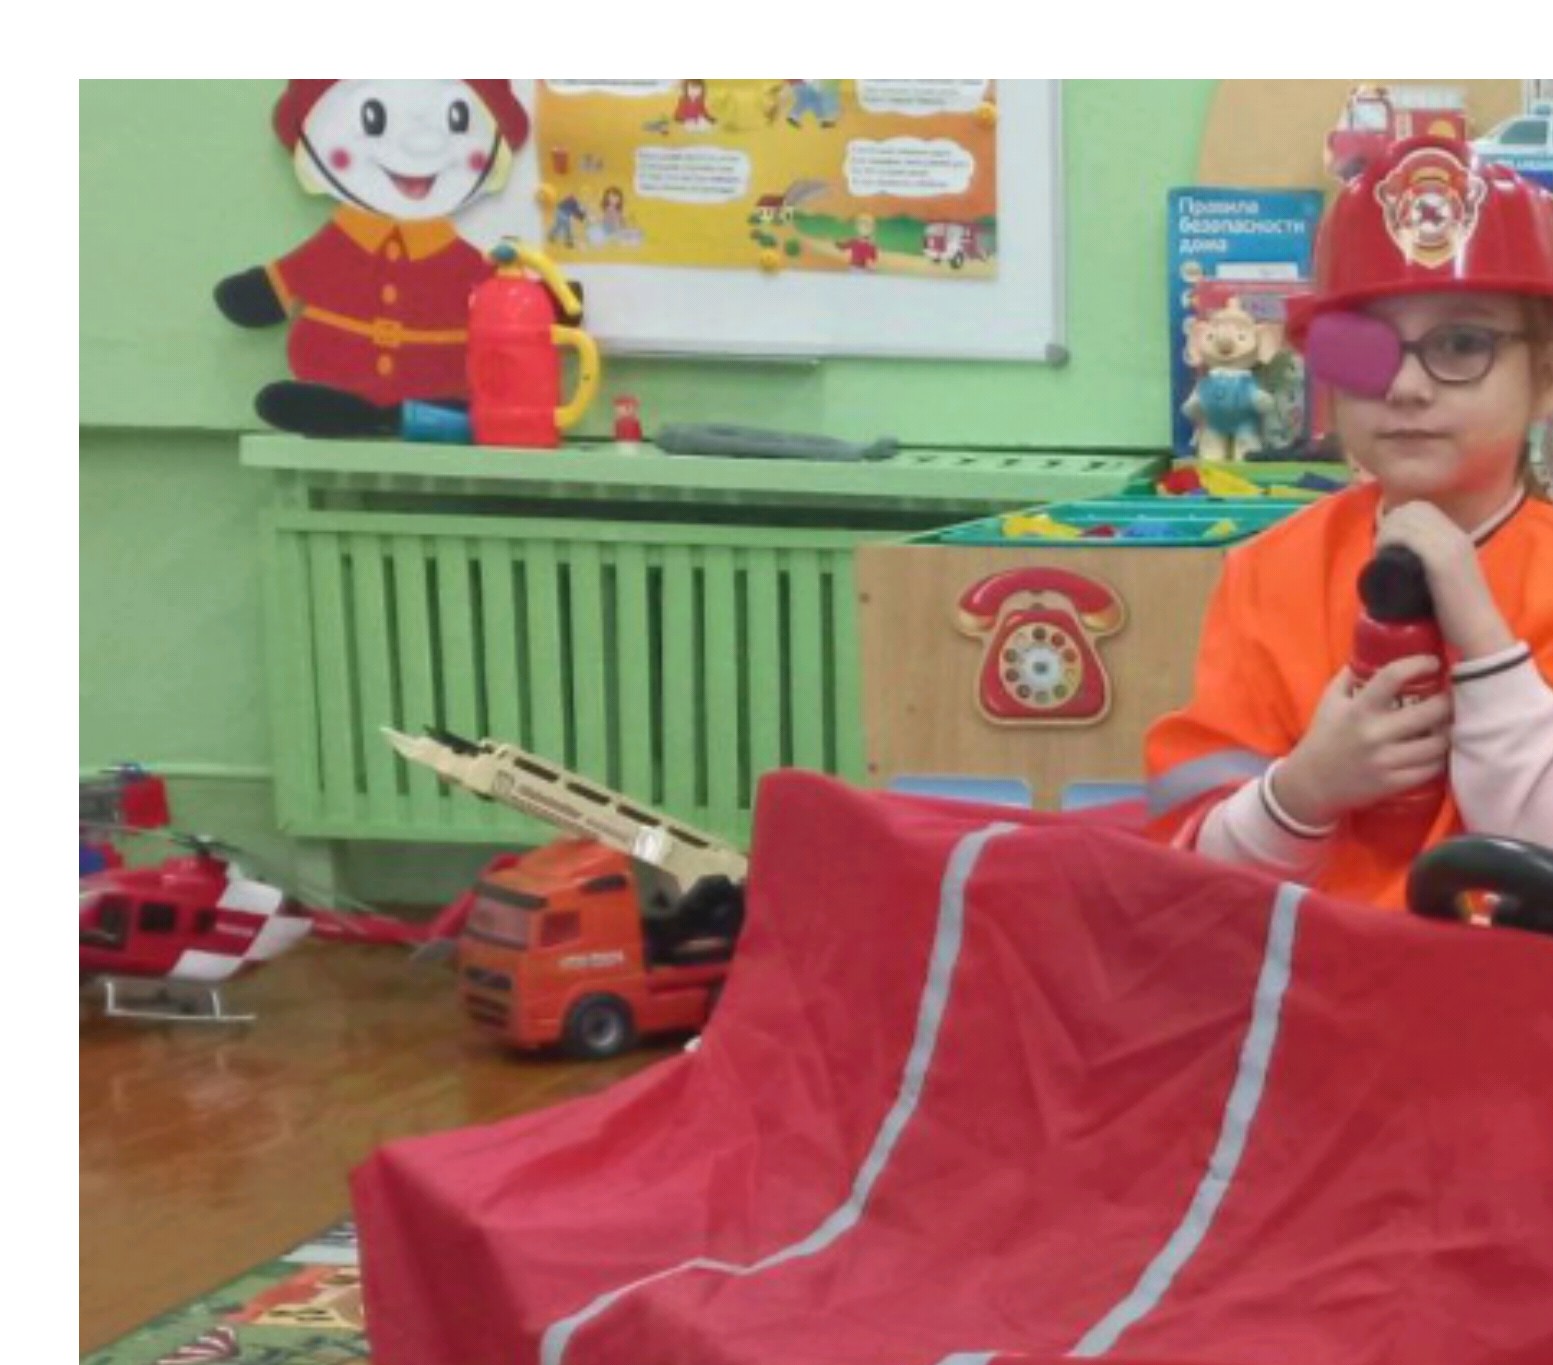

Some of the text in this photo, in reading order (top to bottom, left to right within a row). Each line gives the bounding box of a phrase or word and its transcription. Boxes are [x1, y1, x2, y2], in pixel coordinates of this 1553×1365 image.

[1178, 196, 1259, 215] Правила
[1178, 216, 1305, 234] безопасности
[1178, 238, 1227, 254] дома
